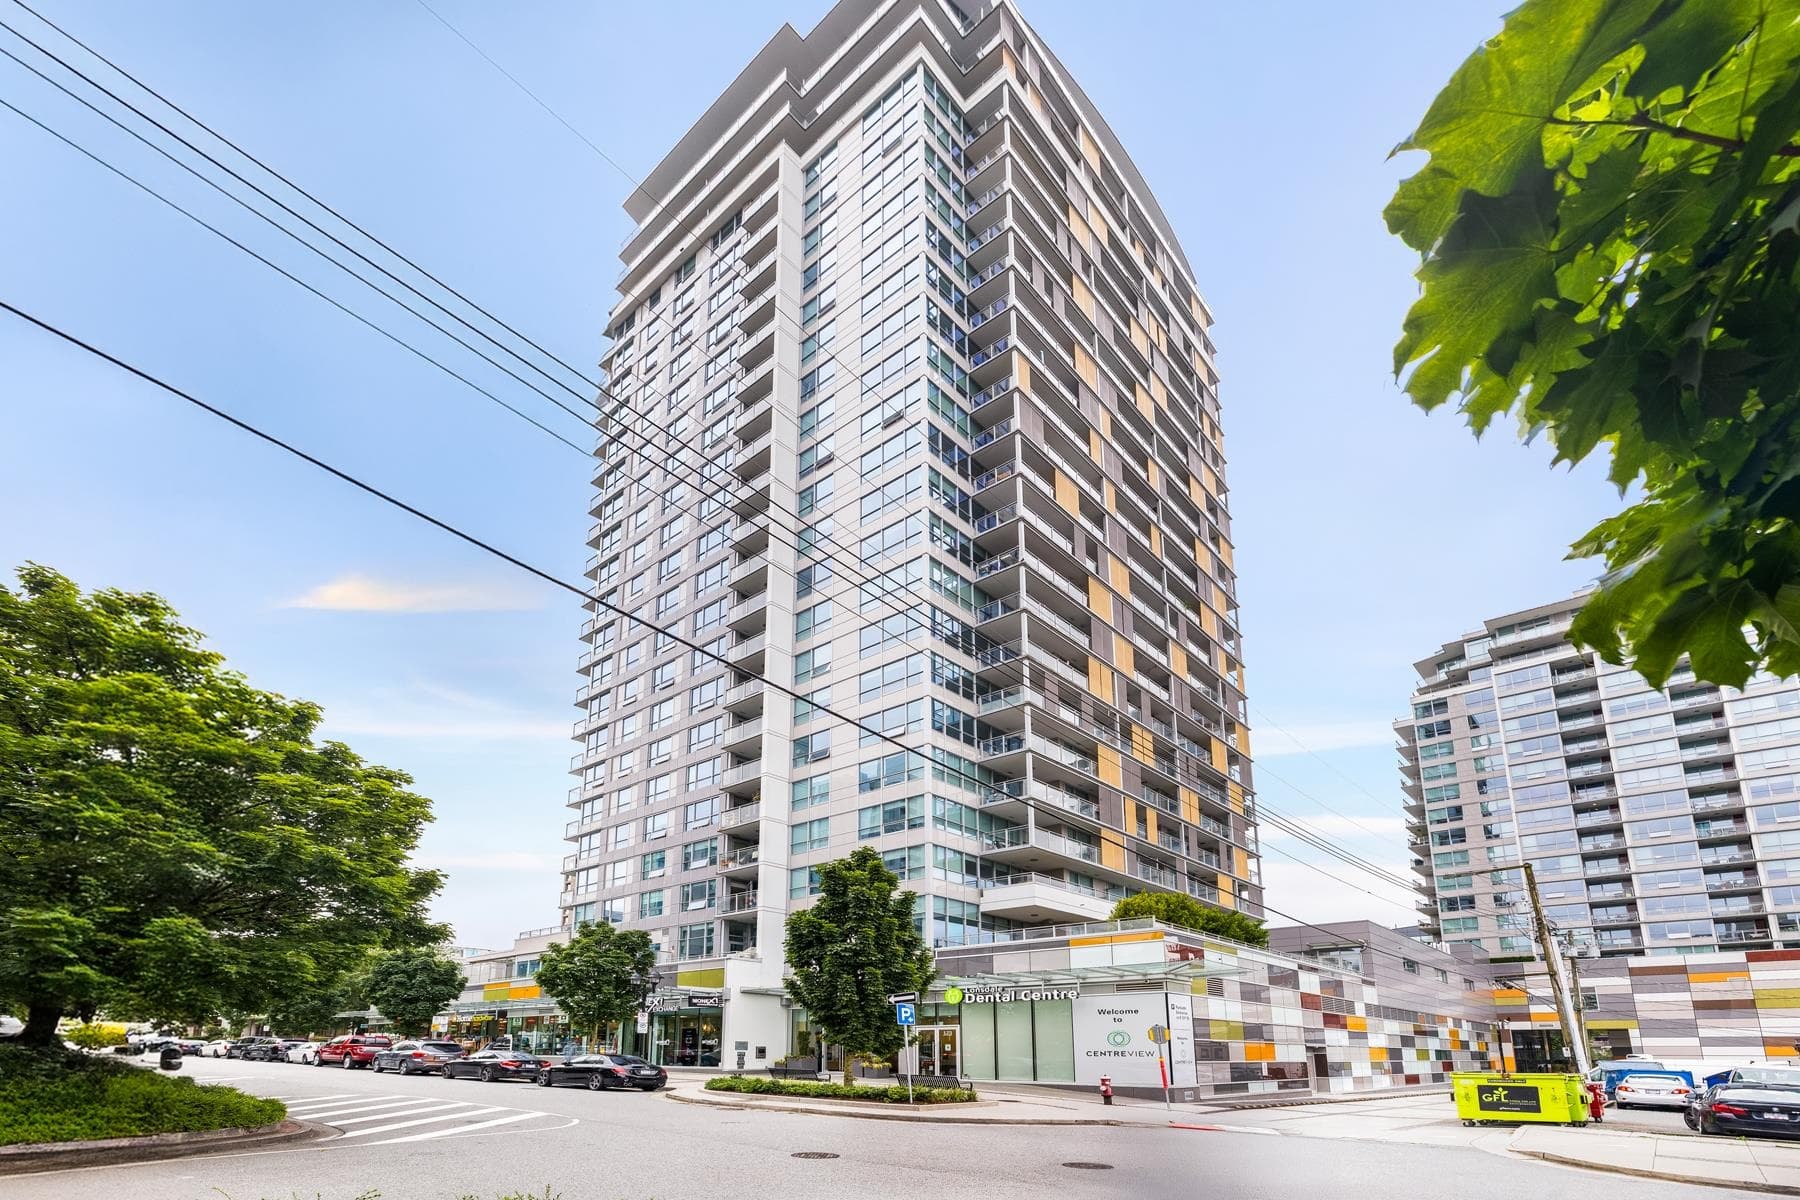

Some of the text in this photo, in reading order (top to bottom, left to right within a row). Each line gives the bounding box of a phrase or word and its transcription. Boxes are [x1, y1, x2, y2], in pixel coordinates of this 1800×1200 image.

[964, 986, 1004, 994] Lonsdale
[965, 989, 1078, 1004] Dental Centre
[901, 1007, 911, 1021] P
[1482, 1090, 1509, 1102] GFL
